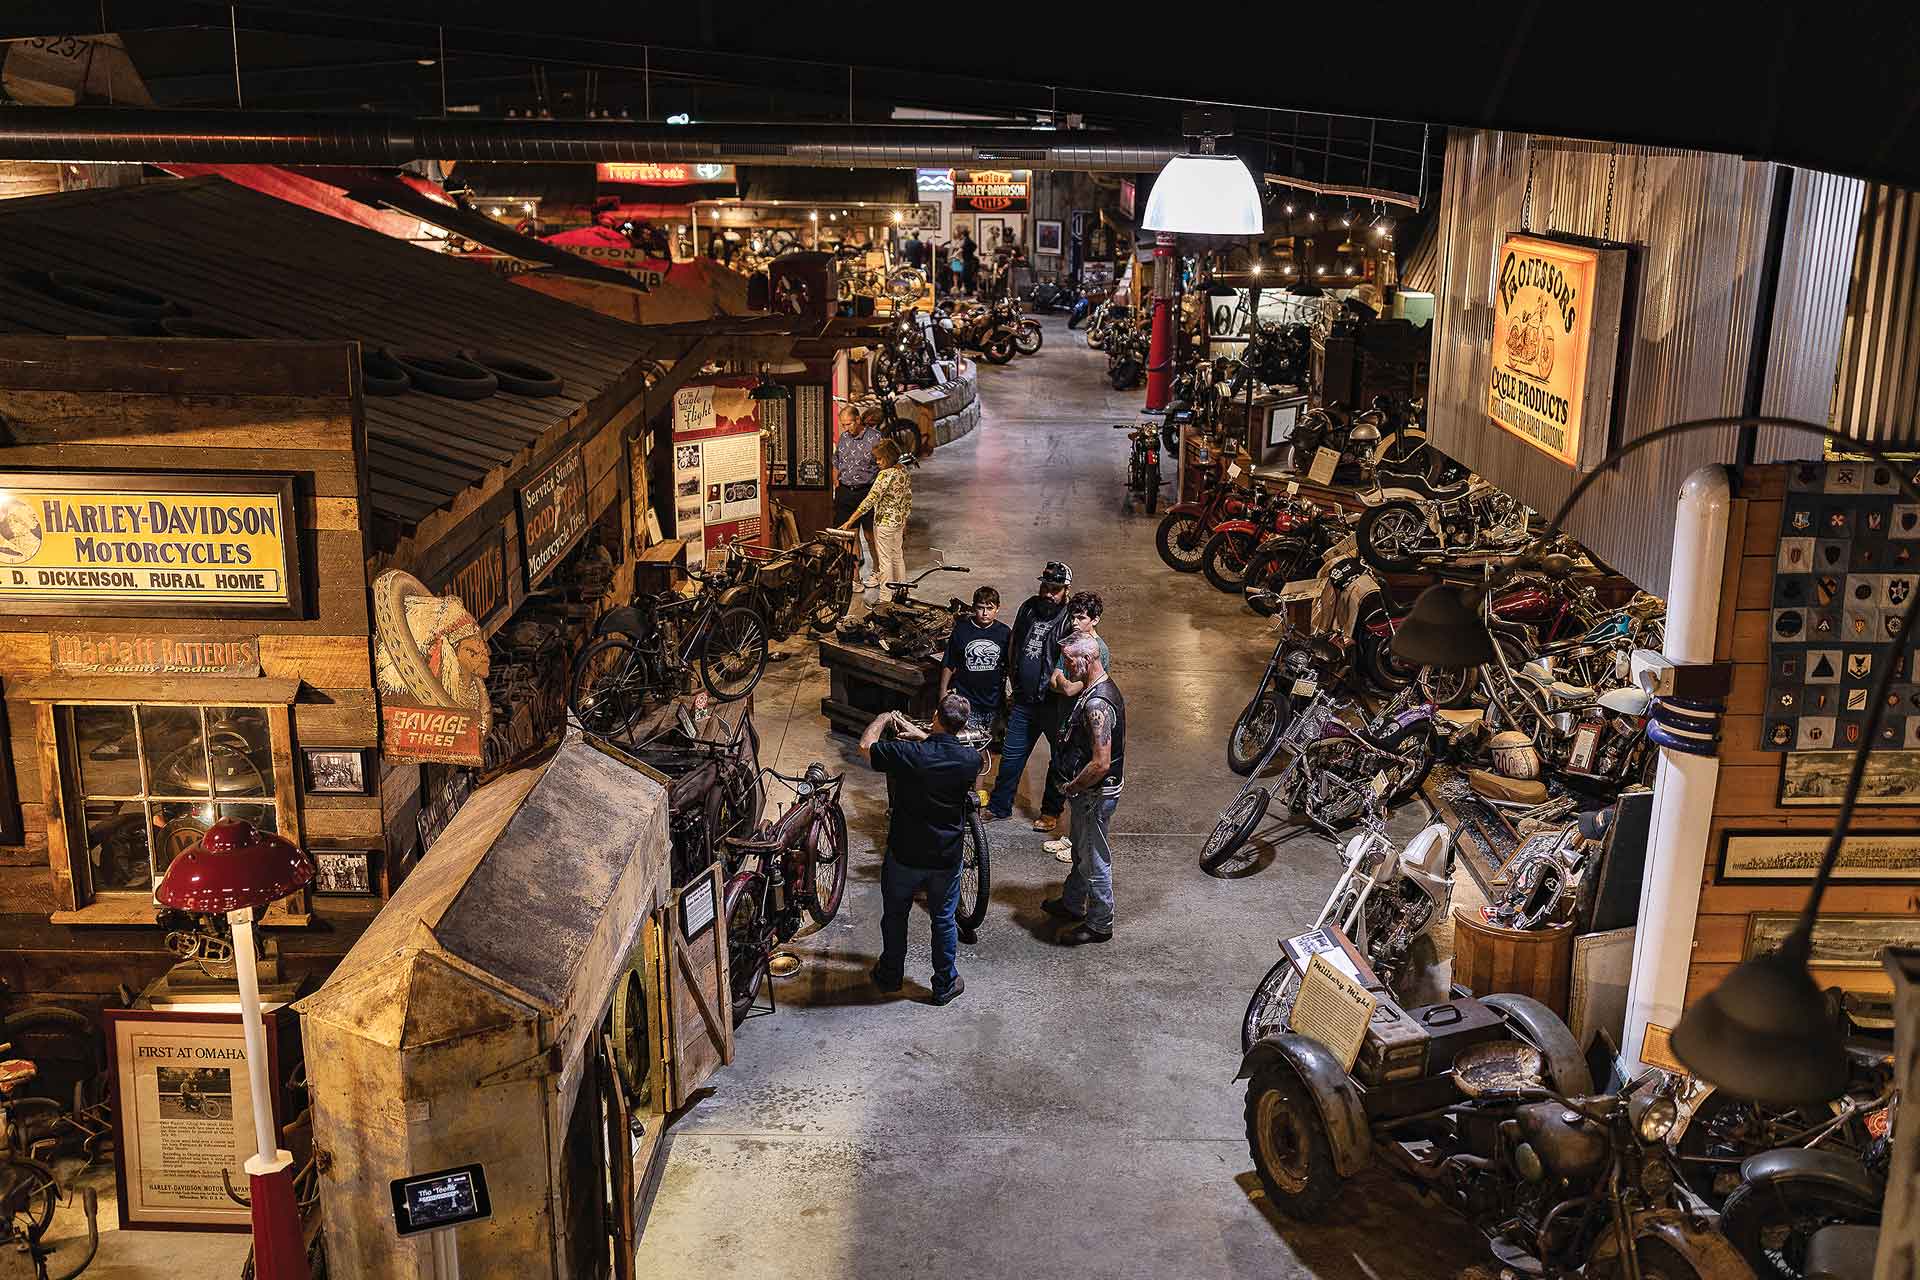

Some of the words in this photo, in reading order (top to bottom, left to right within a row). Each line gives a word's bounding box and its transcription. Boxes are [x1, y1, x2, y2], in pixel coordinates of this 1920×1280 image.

[977, 173, 1005, 183] MOTOR
[956, 184, 1026, 197] HARLEY-DAVIDSON
[1499, 251, 1577, 334] PROFESSOR'S
[678, 388, 702, 409] Eagle
[1491, 365, 1518, 400] CYCLE
[1518, 379, 1569, 425] PRODUCTS
[684, 398, 713, 429] Flight
[525, 477, 556, 509] Service
[555, 454, 579, 483] Station
[43, 500, 276, 537] HARLEY-DAVIDSON
[74, 537, 252, 565] MOTORCYCLES
[528, 526, 570, 578] Motorcycle
[570, 509, 586, 540] Tires
[13, 570, 28, 585] D.
[149, 573, 205, 588] RURAL
[215, 574, 265, 589] HOME
[161, 639, 253, 666] BATTERIES
[967, 656, 996, 666] EAST
[84, 664, 97, 672] A
[103, 663, 158, 674] Quality
[161, 664, 228, 673] Product
[394, 711, 471, 735] SAVAGE
[408, 732, 455, 747] TIRES
[1313, 959, 1345, 992] Military
[1347, 984, 1371, 1009] Might
[138, 1046, 174, 1059] FIRST
[176, 1047, 193, 1058] AT
[195, 1047, 246, 1060] OMAHA
[149, 1183, 202, 1192] HARLEY-DAVIDSON
